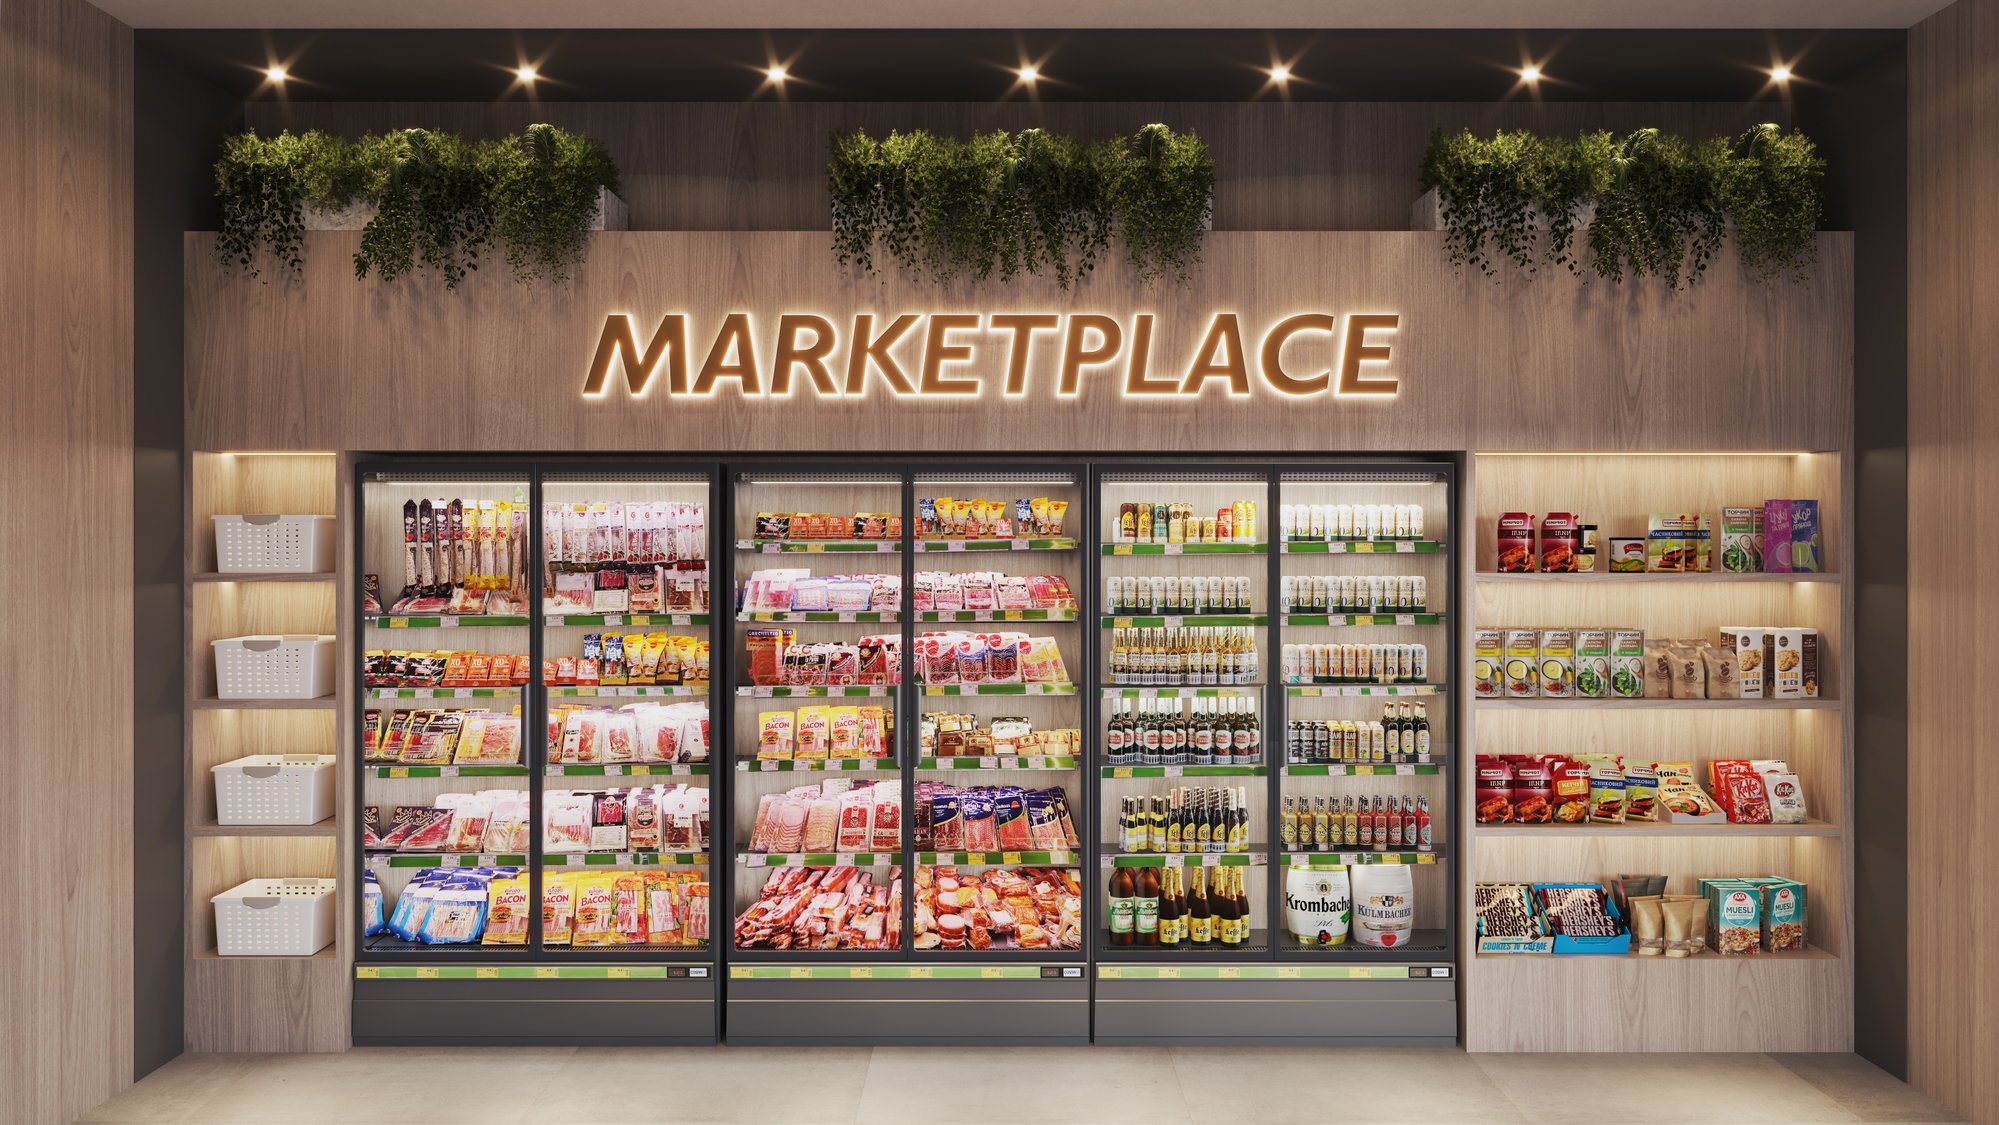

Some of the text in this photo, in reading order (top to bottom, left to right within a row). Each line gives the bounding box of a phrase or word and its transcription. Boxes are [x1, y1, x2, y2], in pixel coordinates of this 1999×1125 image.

[582, 313, 1400, 396] MARKETPLACE
[765, 722, 789, 730] BACON
[801, 722, 824, 730] BACON
[834, 719, 858, 728] BACON
[1737, 778, 1759, 798] KitKat
[496, 895, 526, 904] BACON
[581, 895, 611, 906] BACON
[1357, 903, 1412, 919] KULMBACHER
[1776, 903, 1793, 912] MUESLI
[1561, 915, 1614, 926] HERSHEY'S
[1563, 926, 1615, 936] HERSHEY'S
[1482, 942, 1510, 950] COOKIES
